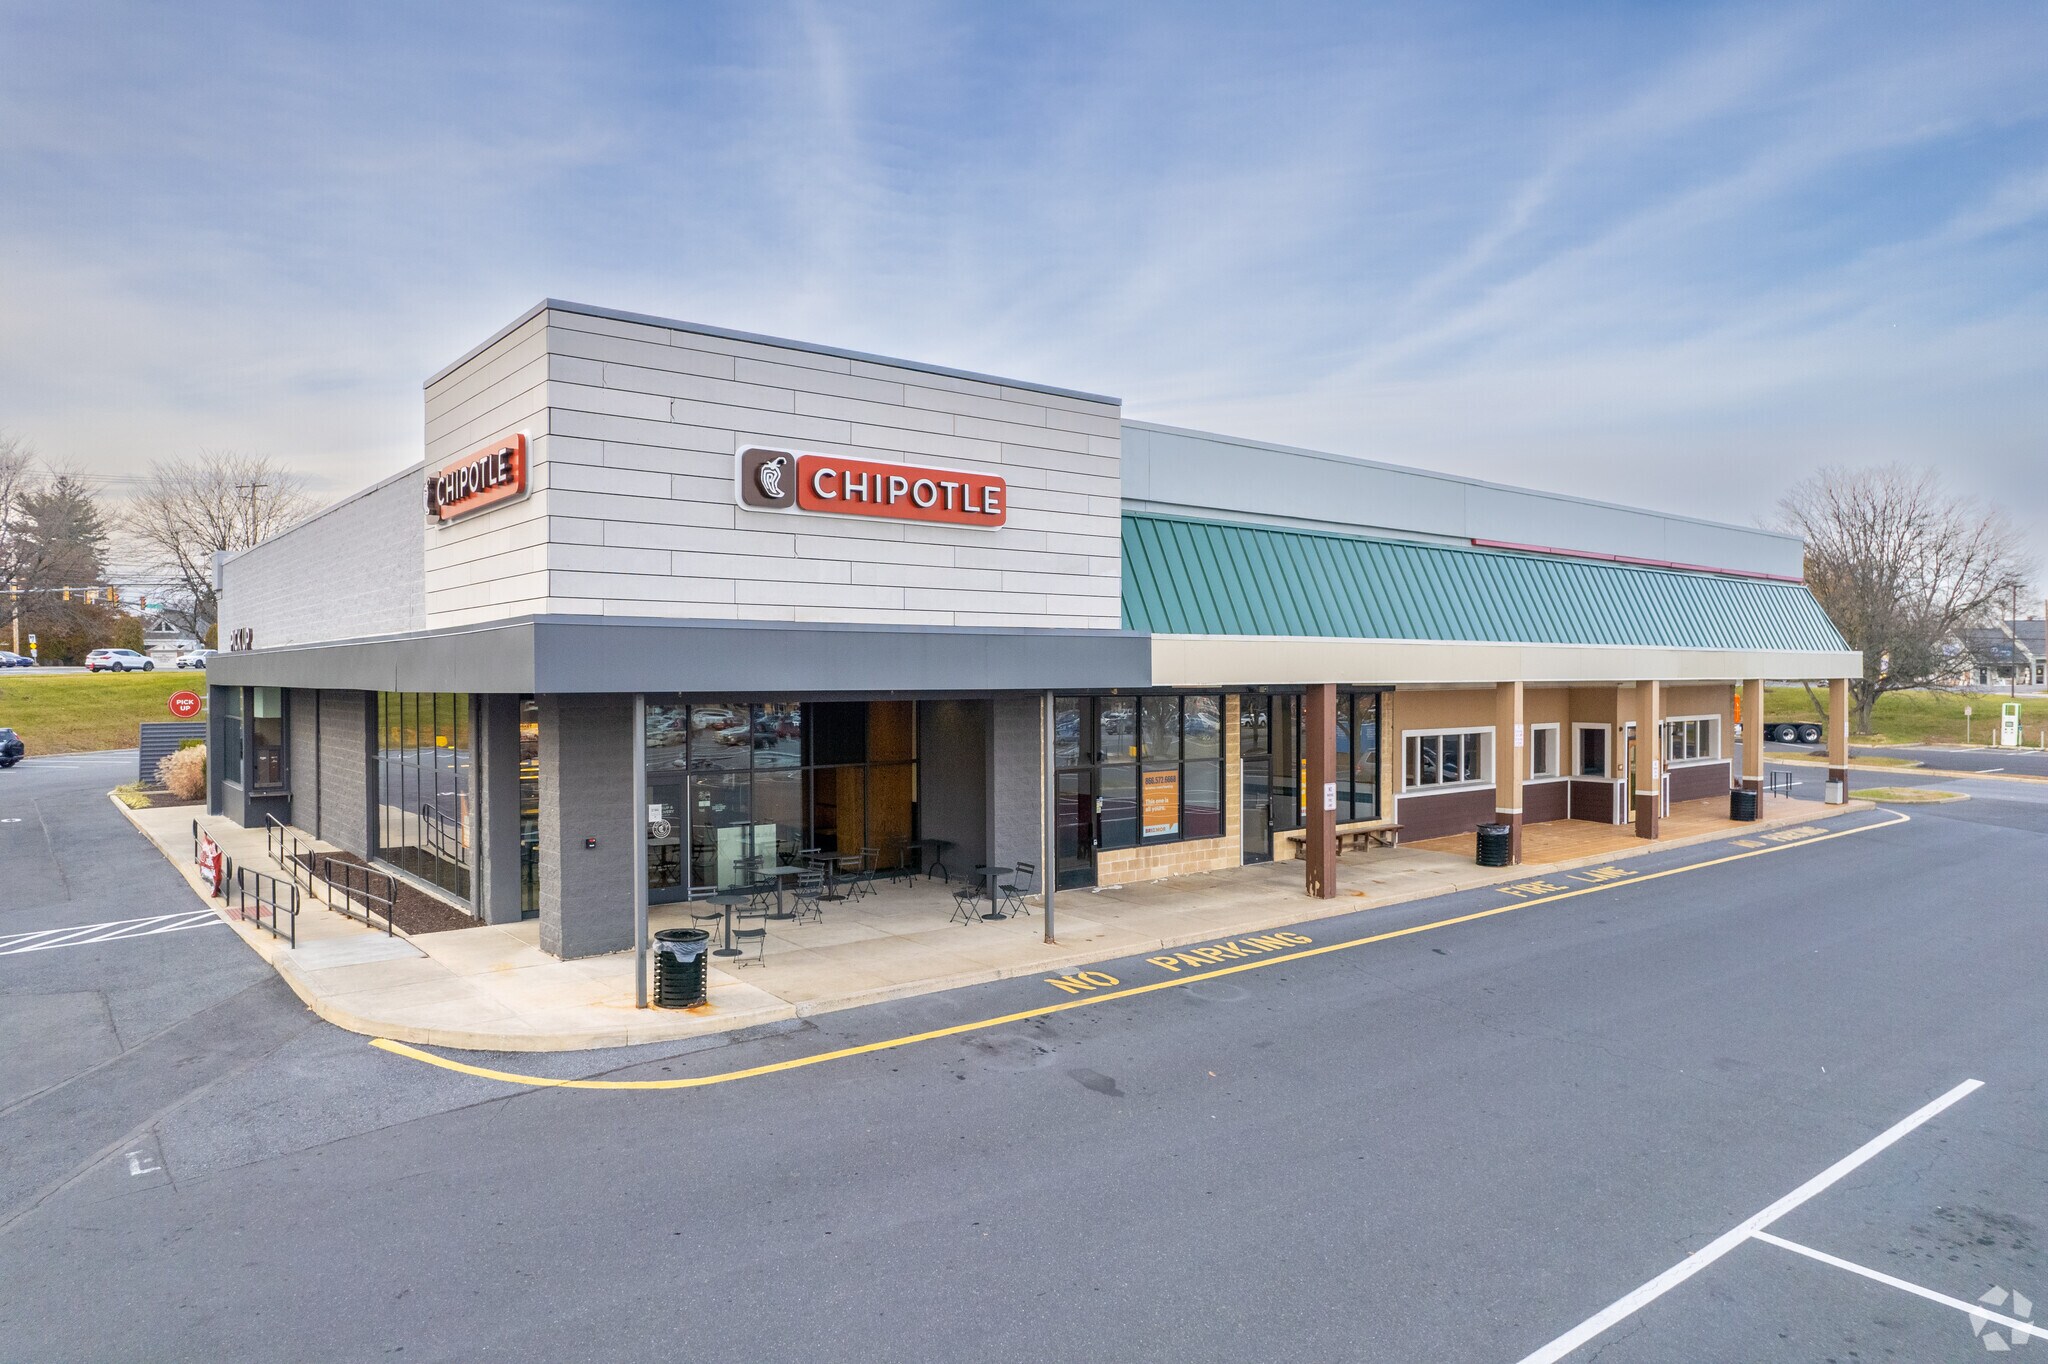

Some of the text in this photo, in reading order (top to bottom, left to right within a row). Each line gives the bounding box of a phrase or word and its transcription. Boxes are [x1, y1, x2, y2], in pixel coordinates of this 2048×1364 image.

[437, 447, 508, 506] CHIPOTLE
[812, 467, 1001, 515] CHIPOTLE
[1496, 866, 1639, 898] FIRE LANE
[1044, 932, 1313, 994] NO PARKING
